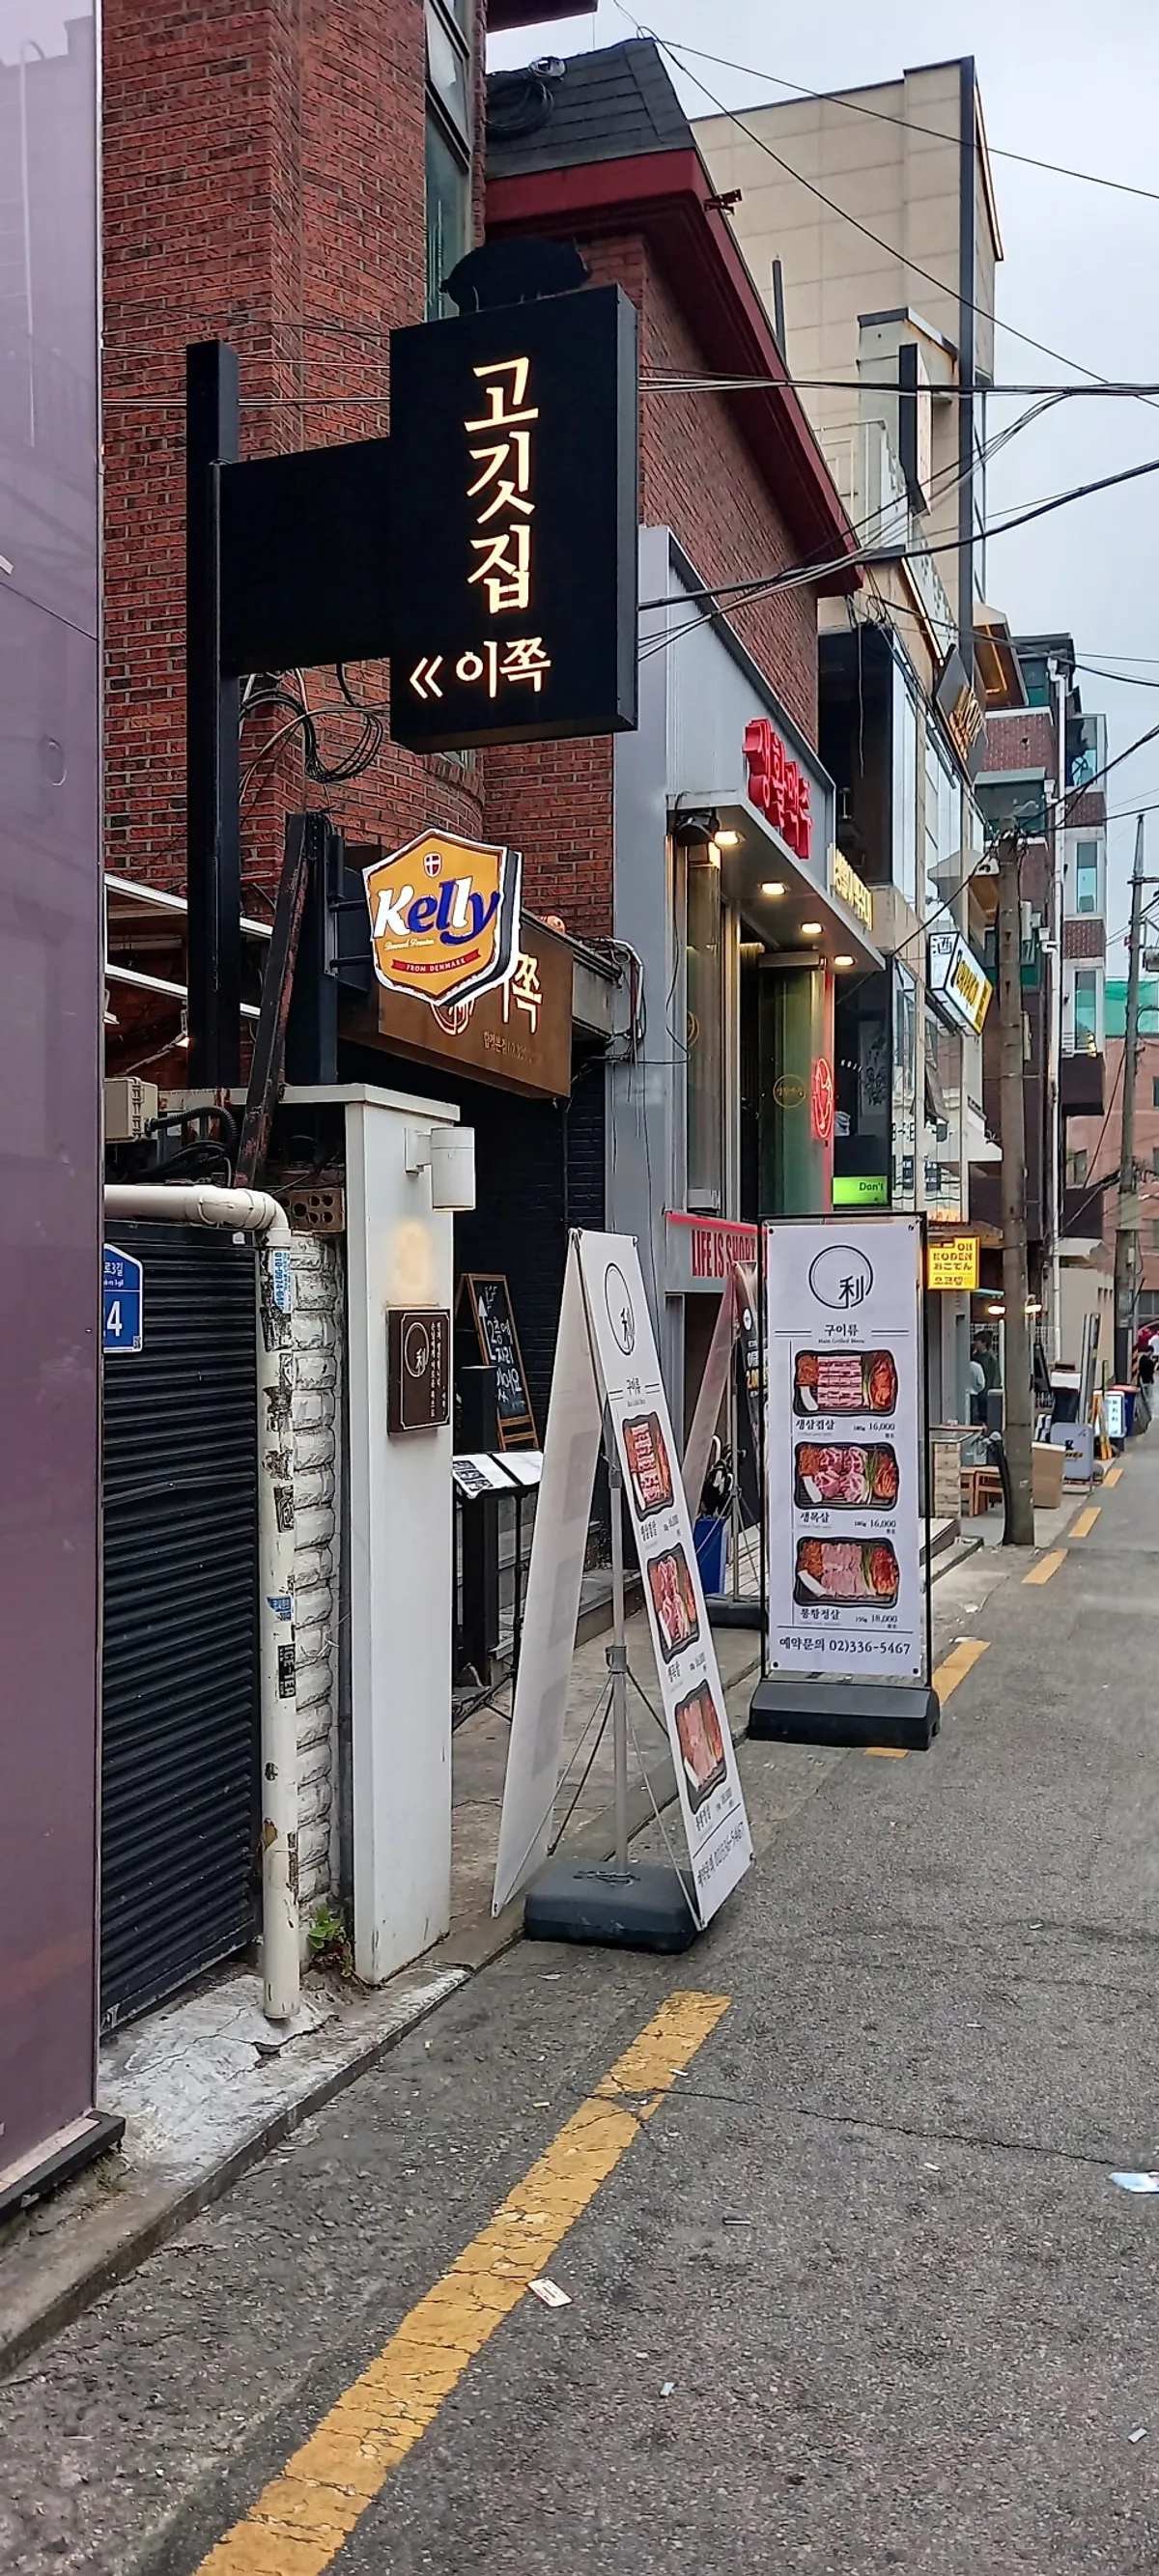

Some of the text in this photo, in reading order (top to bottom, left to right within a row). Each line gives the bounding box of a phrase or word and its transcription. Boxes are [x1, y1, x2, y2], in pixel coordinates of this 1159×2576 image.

[464, 355, 539, 614] 고깃집
[456, 636, 551, 698] 이쪽
[374, 876, 500, 946] Kelly
[429, 957, 466, 972] DENMARK
[859, 1181, 884, 1191] Don't
[692, 1230, 712, 1277] LIFE
[714, 1231, 723, 1278] IS
[103, 1300, 123, 1337] 4
[869, 1423, 895, 1431] 16,000
[870, 1519, 896, 1528] 16,000
[779, 1636, 911, 1656] 예약문의 02)336-5467
